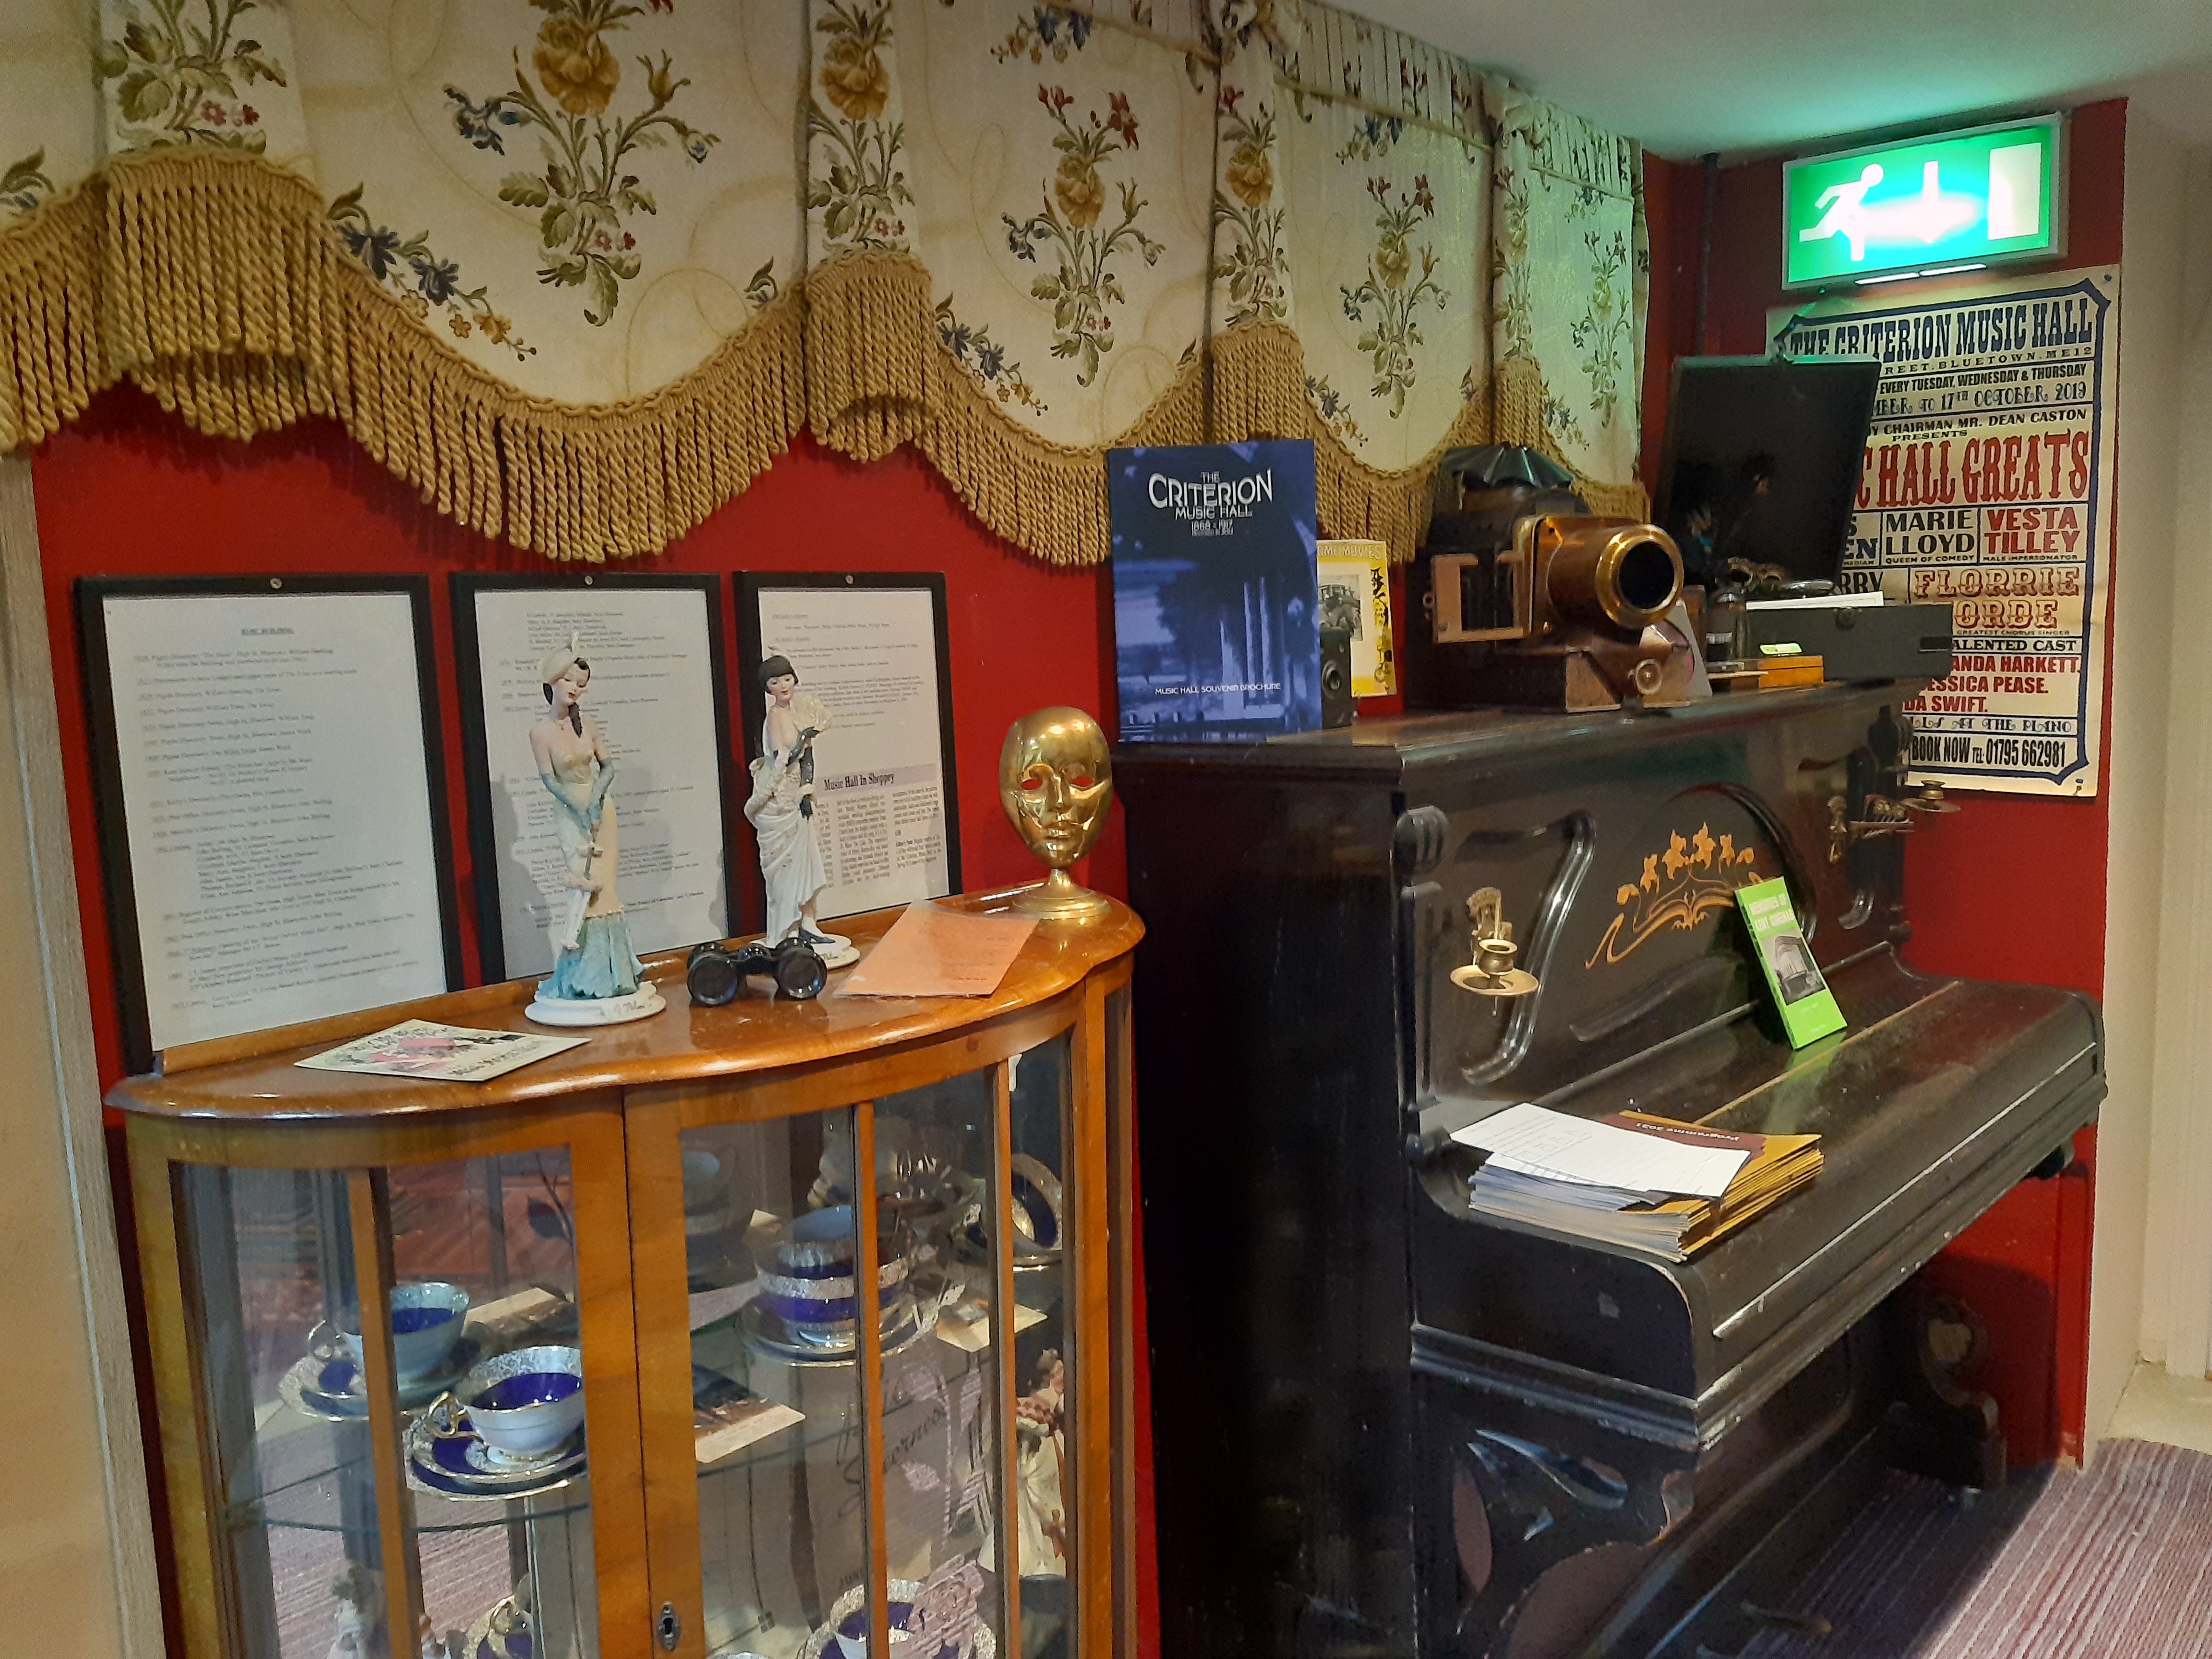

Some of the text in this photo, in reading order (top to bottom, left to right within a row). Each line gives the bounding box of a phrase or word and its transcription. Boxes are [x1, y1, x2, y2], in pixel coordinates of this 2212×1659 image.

[1791, 298, 2092, 363] THE CRITERION MUSIC HALL
[1880, 380, 1910, 394] EVERY
[1958, 370, 2019, 386] WEDNESDAY
[2021, 371, 2029, 381] &
[2031, 363, 2087, 380] THURSDAY
[1885, 363, 1935, 374] REET.
[1974, 385, 2048, 407] OCTOBER
[2055, 381, 2087, 400] 2019
[1884, 419, 1953, 435] CHAIRMAN
[1958, 417, 1983, 428] MR.
[1988, 413, 2025, 426] DEAN
[2030, 409, 2086, 423] CASTON
[1892, 430, 1968, 441] PRESENTS
[1201, 471, 1220, 483] THE
[1876, 440, 1956, 507] HALL
[1961, 428, 2089, 503] GREATS
[1148, 467, 1273, 509] CRITERION
[1176, 504, 1253, 520] MUSIC HALL
[1886, 510, 1973, 532] MARIE
[1987, 507, 2078, 531] VESTA
[1317, 544, 1382, 560] OME MOVIES
[1886, 533, 1974, 555] LLOYD
[1984, 530, 2080, 554] TILLEY
[1840, 572, 1884, 594] RRY
[1914, 567, 2080, 599] FLORRIE
[1955, 600, 2058, 629] ORDE
[1953, 640, 2077, 651] ALENTED CAST
[1951, 655, 2080, 673] ANDA HARKETT.
[1922, 676, 2049, 694] ESSICA PEASE.
[1902, 696, 1988, 712] DA SWIFT.
[1951, 717, 1973, 729] AT
[1982, 719, 2016, 731] THE
[2022, 721, 2072, 733] PIANO
[1912, 736, 1941, 762] BOOK
[1944, 737, 1971, 763] NOW
[1986, 738, 2019, 766] 01795
[2021, 739, 2066, 768] 662981
[824, 778, 843, 791] Music
[845, 775, 858, 788] Hall
